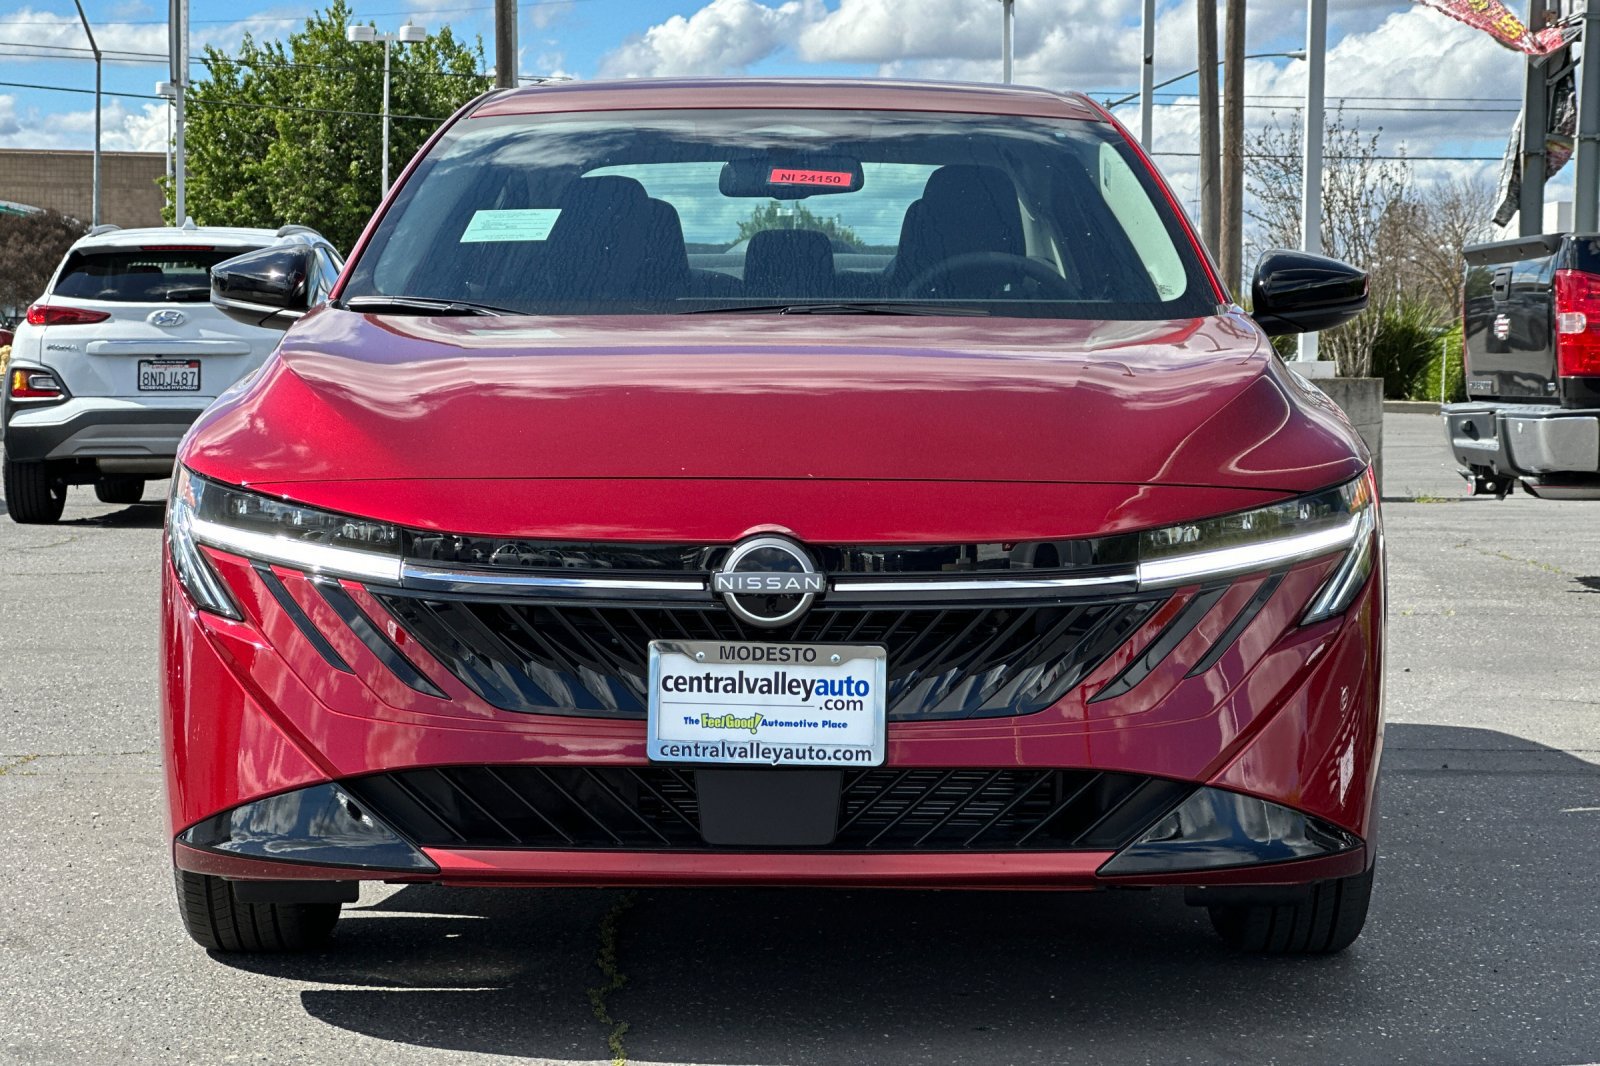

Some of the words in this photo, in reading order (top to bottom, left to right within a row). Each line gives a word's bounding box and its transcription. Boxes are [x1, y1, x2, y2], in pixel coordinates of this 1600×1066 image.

[780, 173, 796, 181] NI
[800, 174, 841, 184] 24150
[142, 371, 197, 386] 8NDJ487
[718, 577, 820, 590] NISSAN
[719, 645, 817, 663] MODESTO
[661, 670, 870, 702] centralvalleyauto
[819, 698, 864, 711] .com
[683, 716, 700, 725] The
[761, 718, 819, 728] Automotive
[821, 719, 848, 729] Place
[660, 740, 872, 763] centralvalleyauto.com
